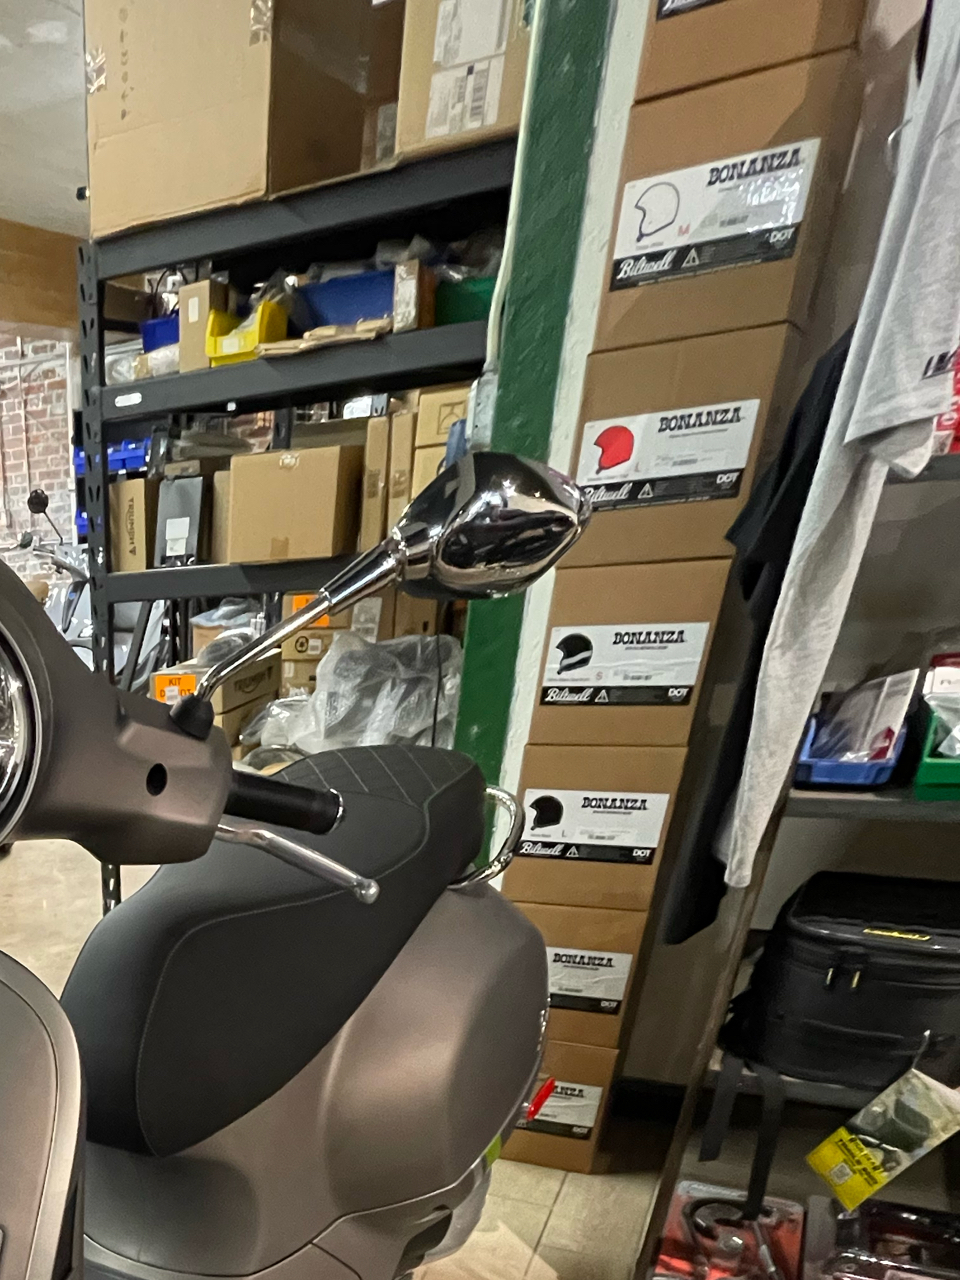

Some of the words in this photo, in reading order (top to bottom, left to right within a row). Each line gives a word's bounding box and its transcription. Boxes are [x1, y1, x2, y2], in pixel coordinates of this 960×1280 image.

[706, 147, 801, 187] BONANZA
[678, 224, 690, 236] M
[769, 227, 796, 243] DOT
[617, 250, 677, 279] Biltwell
[658, 406, 742, 433] BONANZA
[716, 472, 740, 484] DOT
[613, 630, 685, 645] BONANZA
[168, 677, 182, 687] KIT
[595, 671, 604, 681] S
[545, 687, 594, 701] Biltwell
[668, 688, 689, 697] DOT
[581, 796, 649, 811] BONANZA
[519, 842, 565, 855] Biltwell
[632, 849, 651, 857] DOT
[552, 952, 615, 968] BONANZA
